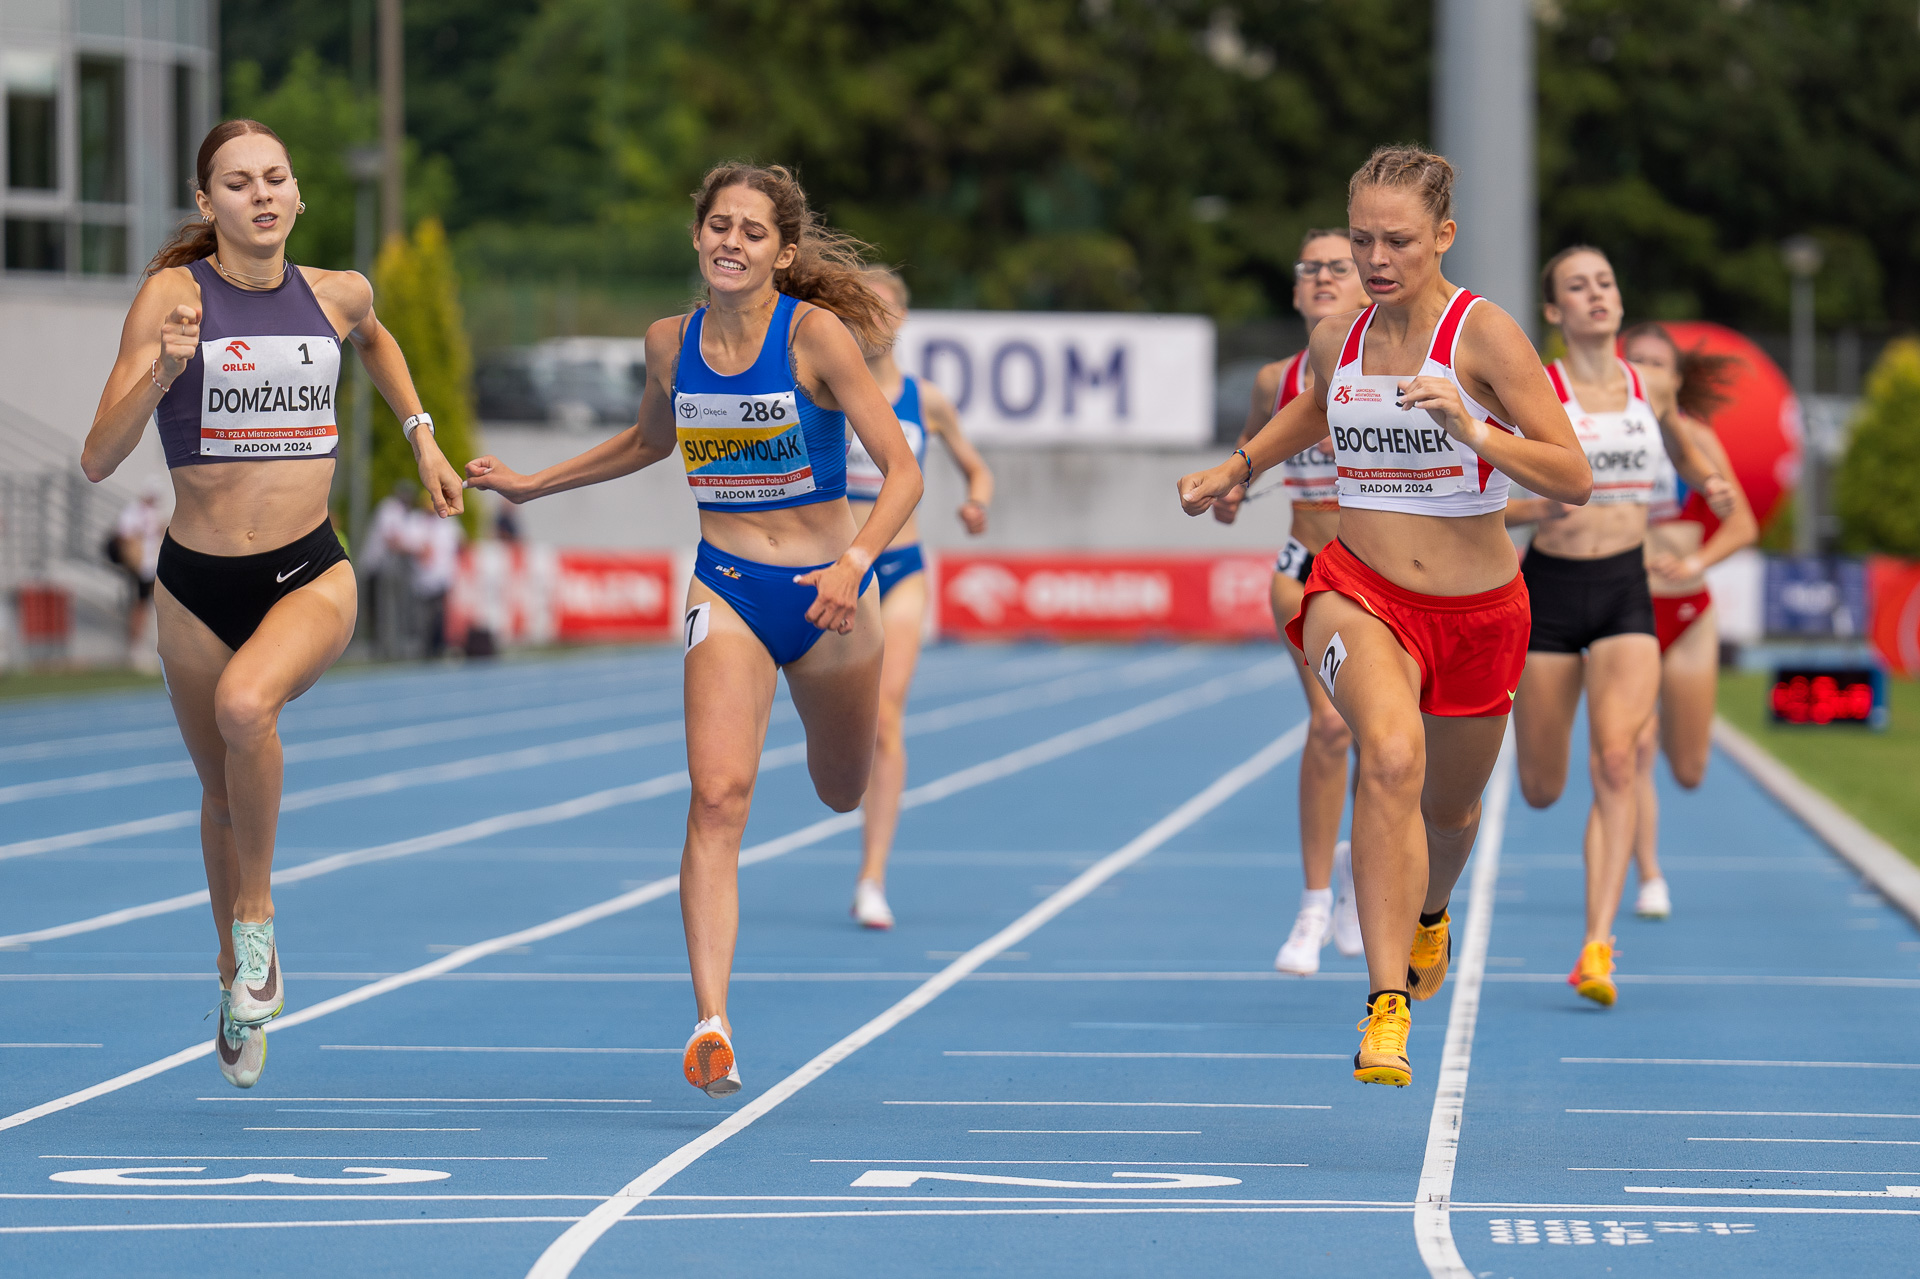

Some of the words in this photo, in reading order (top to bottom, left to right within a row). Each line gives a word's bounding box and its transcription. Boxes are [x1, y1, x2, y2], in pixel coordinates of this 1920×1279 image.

[298, 343, 314, 365] 1
[222, 363, 256, 372] ORLEN
[208, 380, 331, 413] DOMŻALSKA
[702, 408, 728, 416] Okęcie
[739, 400, 786, 422] 286
[215, 430, 227, 438] 78.
[247, 430, 294, 438] Mistrzostwa
[295, 429, 314, 437] Polski
[315, 427, 327, 435] U20
[1333, 426, 1455, 454] BOCHENEK
[234, 443, 281, 453] RADOM
[284, 442, 312, 452] 2024
[684, 434, 802, 461] SUCHOWOLAK
[787, 472, 802, 482] U20
[1346, 469, 1354, 477] 78.
[1354, 470, 1370, 478] PZLA
[1413, 471, 1434, 479] Polski
[1435, 468, 1451, 476] U20
[715, 490, 756, 499] RADOM
[757, 488, 786, 498] 2024
[1360, 484, 1402, 493] RADOM
[1404, 483, 1433, 493] 2024
[1277, 542, 1298, 571] 5
[1323, 645, 1341, 686] 2
[49, 1167, 452, 1186] 3
[849, 1170, 1242, 1189] 2
